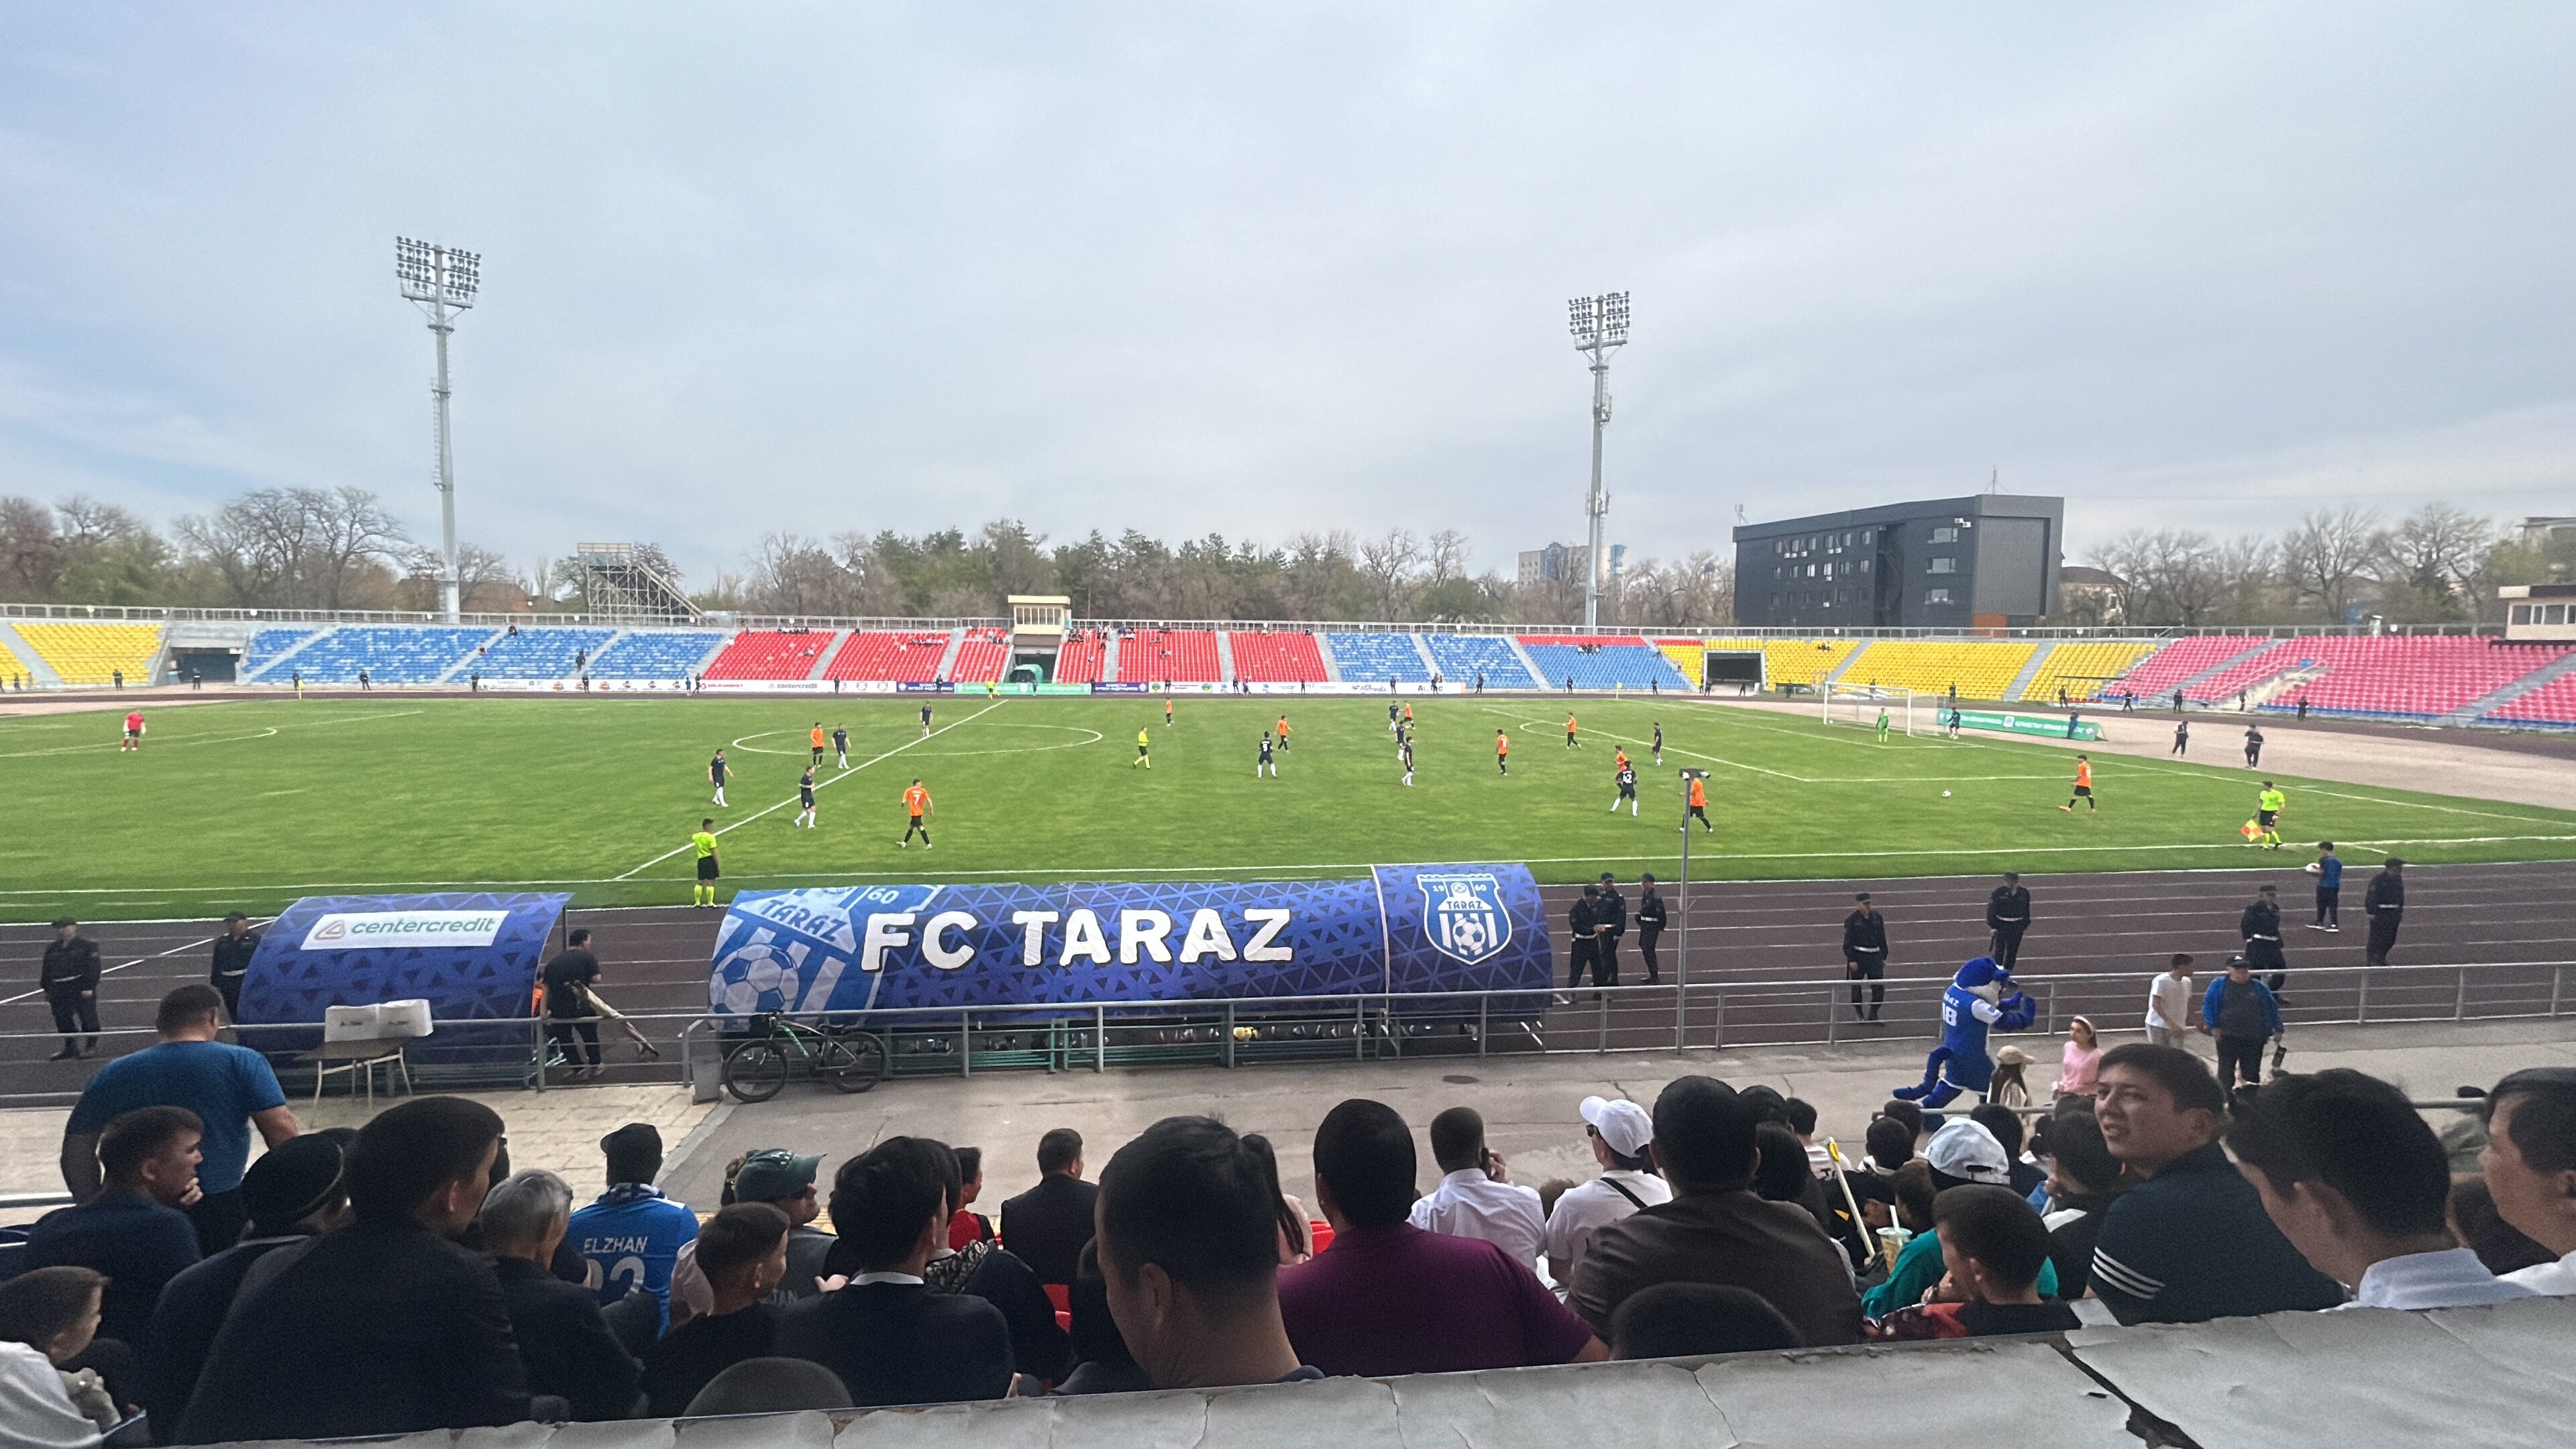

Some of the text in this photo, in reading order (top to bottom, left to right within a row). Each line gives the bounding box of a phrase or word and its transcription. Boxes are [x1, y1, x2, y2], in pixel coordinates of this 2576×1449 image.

[913, 794, 921, 805] 7
[868, 888, 900, 904] 60
[1446, 900, 1483, 909] TARAZ
[352, 918, 495, 934] centercredit
[761, 900, 848, 942] TARAZ
[861, 908, 1293, 970] FC TARAZ
[583, 1236, 648, 1254] ELZHAN
